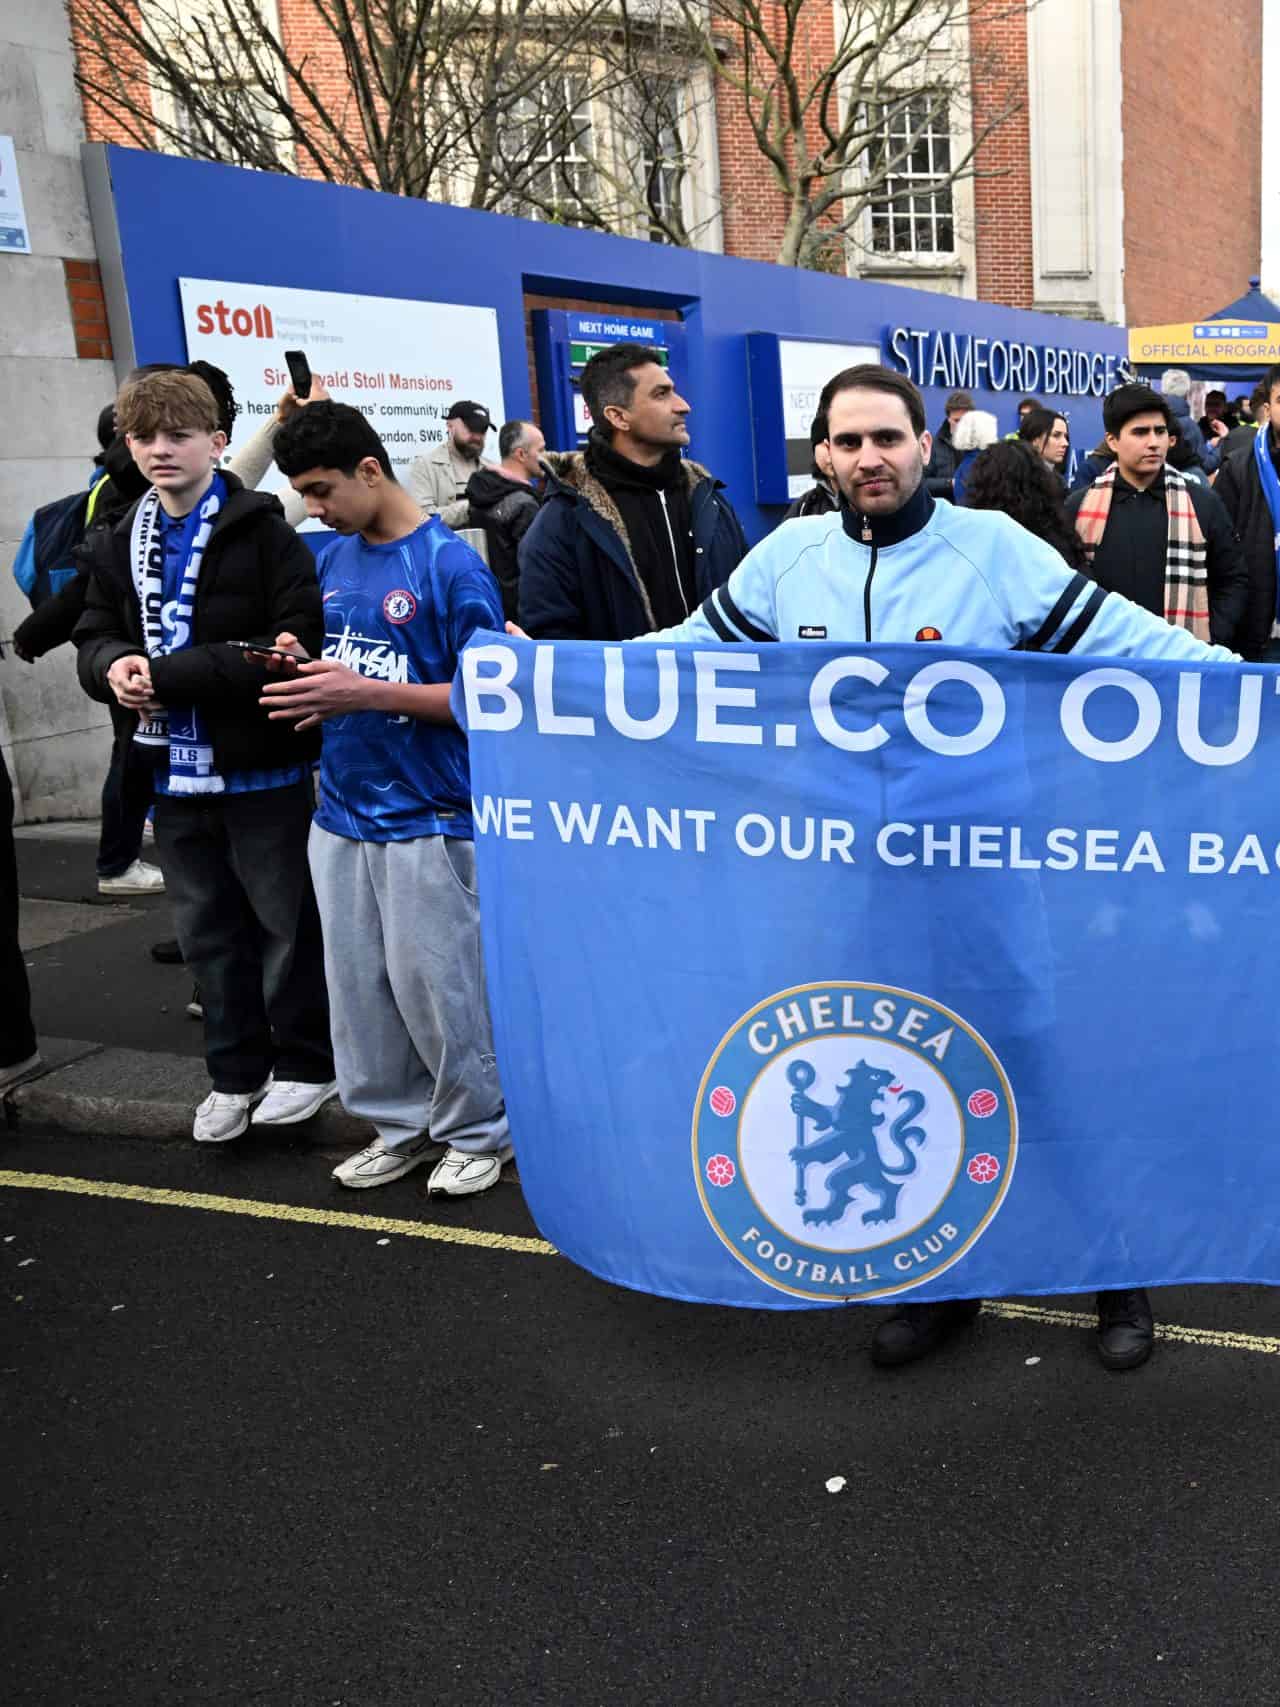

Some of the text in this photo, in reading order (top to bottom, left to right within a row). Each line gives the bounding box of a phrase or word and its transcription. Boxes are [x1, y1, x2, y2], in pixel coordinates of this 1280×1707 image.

[197, 300, 274, 338] stoll
[579, 321, 655, 338] NEXT HOME GAME
[892, 327, 1039, 392] STAMFORD
[1141, 343, 1208, 357] OFFICIAL
[264, 368, 287, 385] Sir
[353, 372, 385, 389] Stoll
[389, 373, 454, 391] Mansions
[247, 401, 279, 415] hear
[380, 403, 439, 419] community
[381, 430, 416, 444] ondon,
[419, 430, 443, 442] SW6
[462, 644, 1006, 757] BLUE.CO
[470, 795, 535, 840] WE
[549, 801, 716, 852] WANT
[735, 813, 855, 864] OUR
[876, 822, 1166, 874] CHELSEA
[749, 994, 955, 1061] CHELSEA
[741, 1222, 959, 1285] FOOTBALL CLUB
